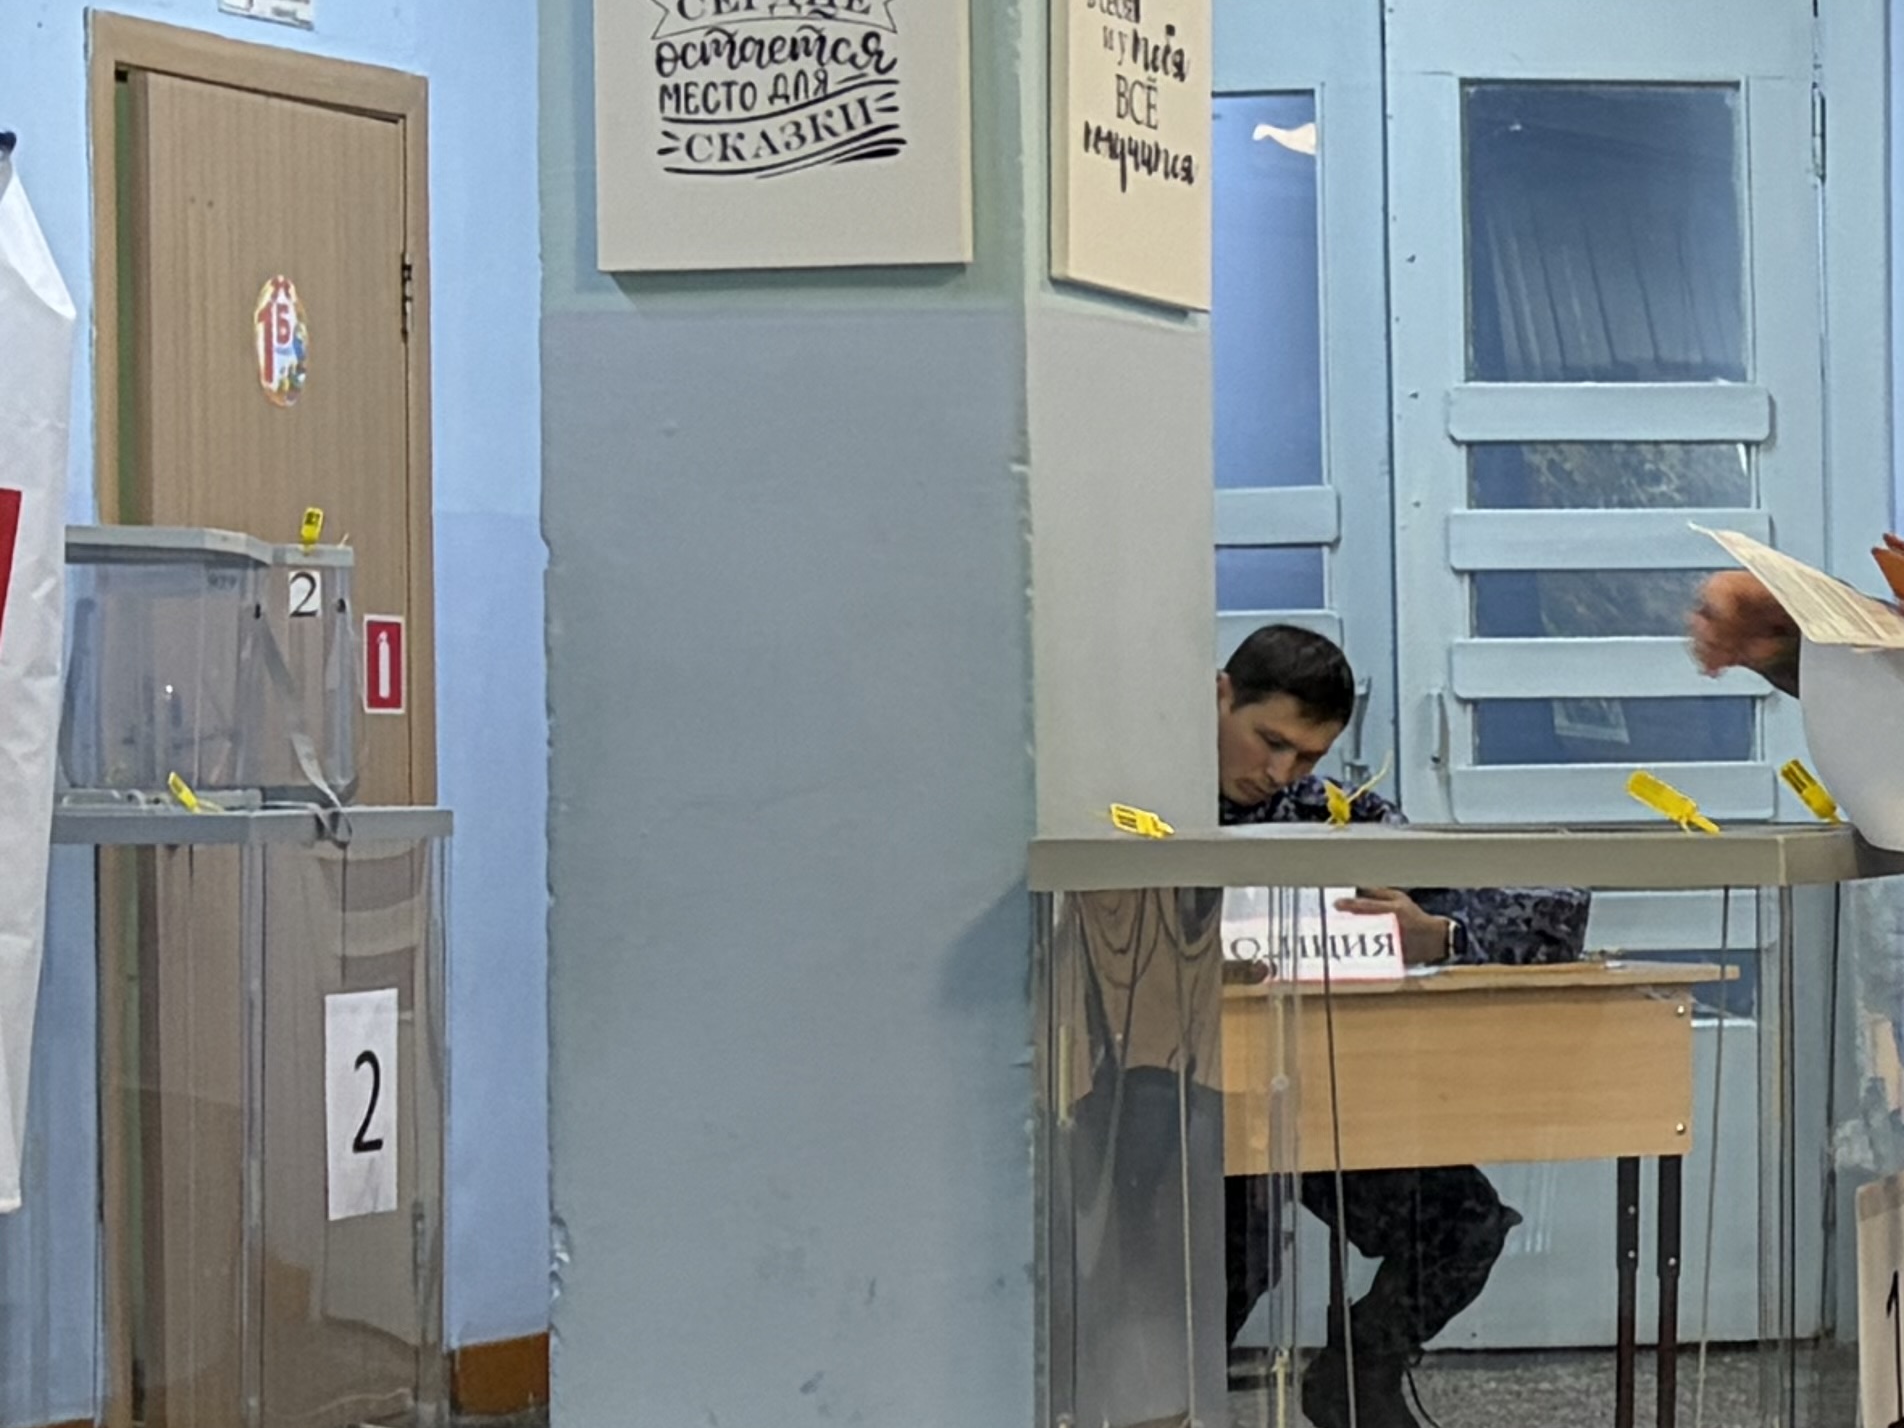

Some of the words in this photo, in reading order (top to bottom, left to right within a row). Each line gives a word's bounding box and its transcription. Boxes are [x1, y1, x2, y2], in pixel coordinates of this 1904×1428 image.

[659, 81, 757, 115] МЕСТО
[768, 68, 829, 106] ДЛЯ
[684, 95, 875, 163] СКАЗКИ
[289, 571, 319, 618] 2
[1229, 932, 1396, 963] ОЛИЦИЯ
[352, 1049, 384, 1154] 2
